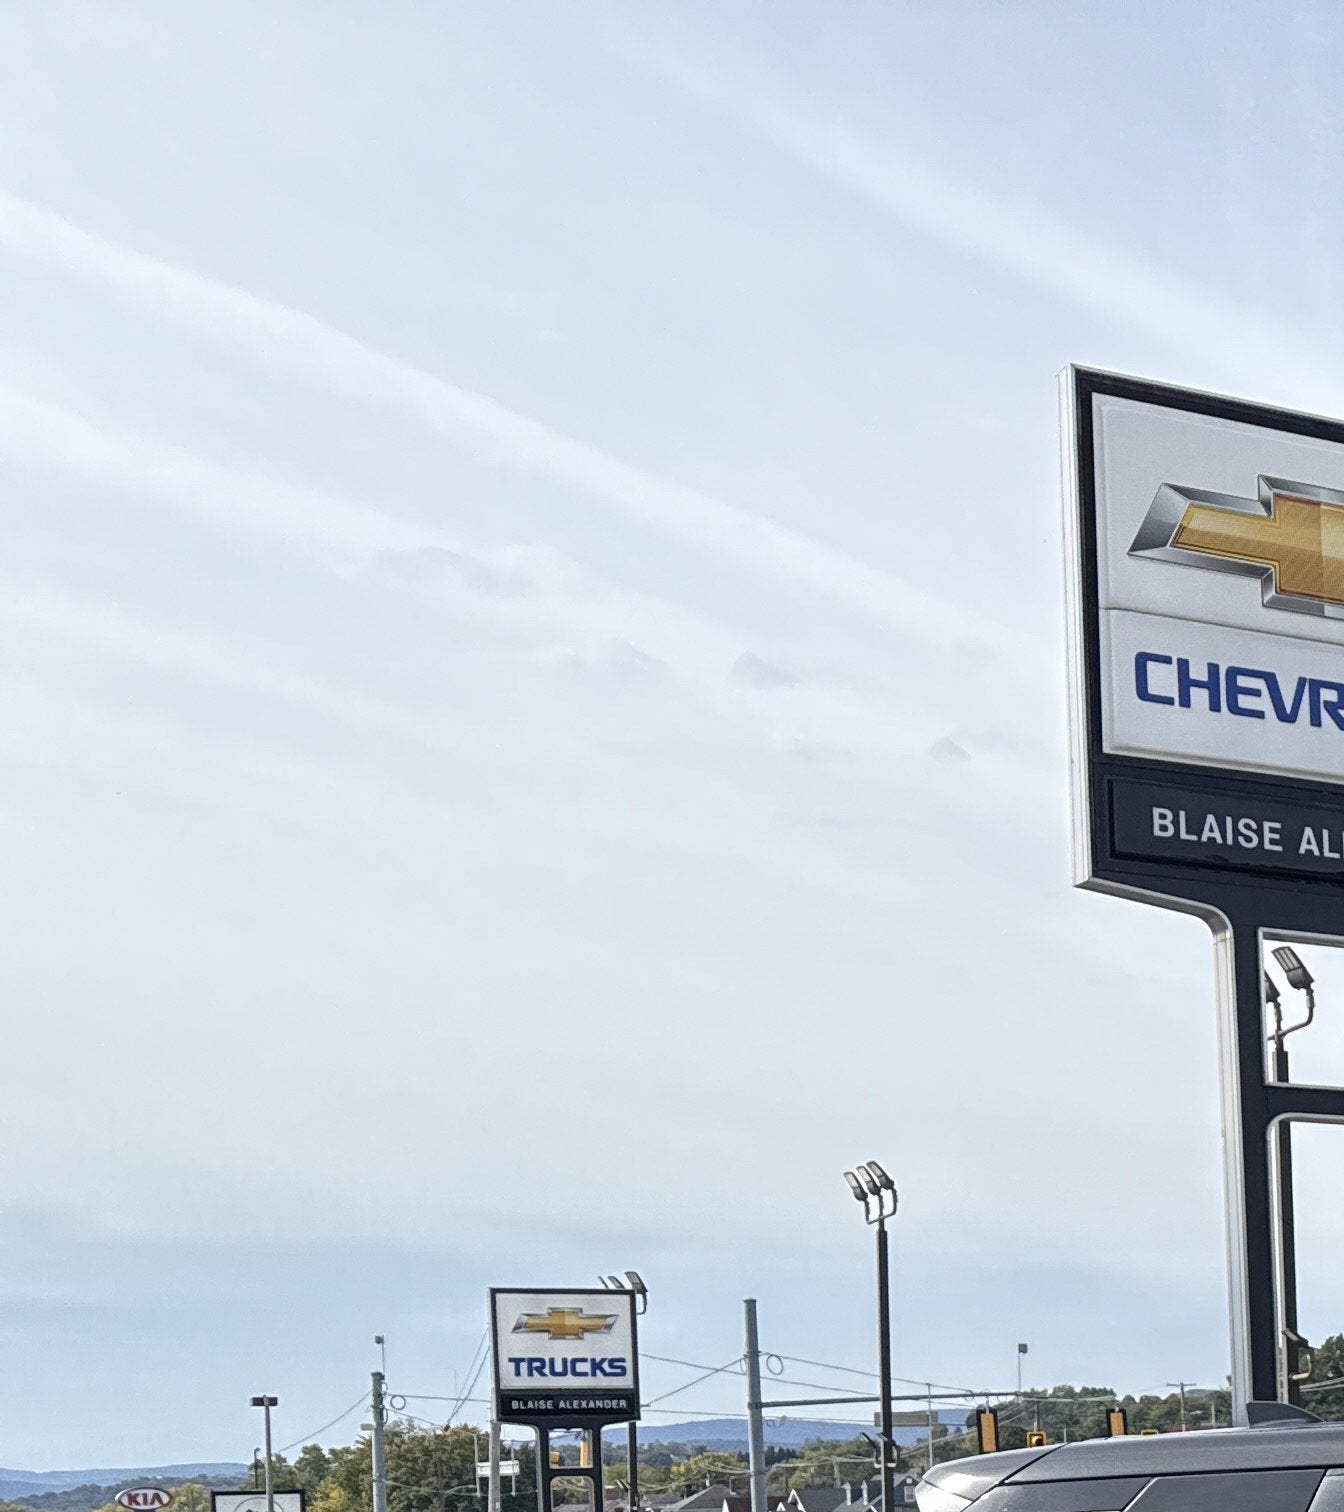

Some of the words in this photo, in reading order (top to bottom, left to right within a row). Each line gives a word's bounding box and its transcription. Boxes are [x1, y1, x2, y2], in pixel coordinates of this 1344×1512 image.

[1152, 806, 1283, 852] BLAISE
[508, 1357, 627, 1378] TRUCKS
[511, 1399, 554, 1410] BLAISE
[558, 1399, 627, 1410] ALEXANDER
[126, 1492, 165, 1506] KIA
